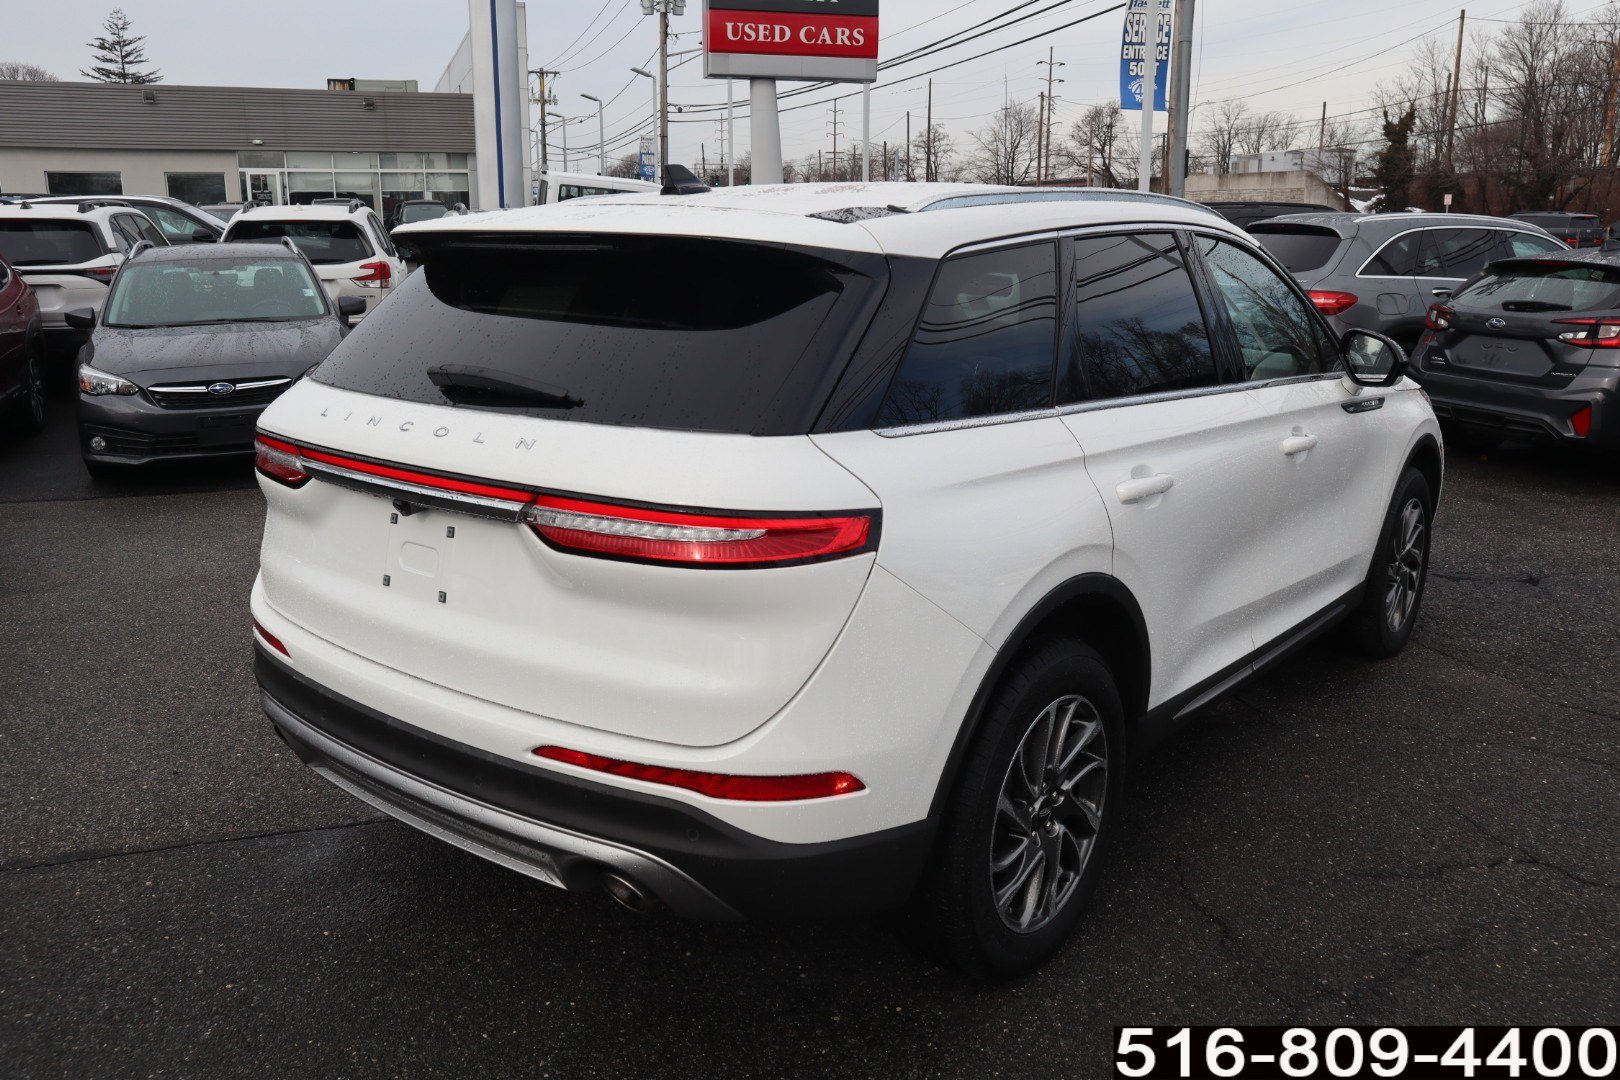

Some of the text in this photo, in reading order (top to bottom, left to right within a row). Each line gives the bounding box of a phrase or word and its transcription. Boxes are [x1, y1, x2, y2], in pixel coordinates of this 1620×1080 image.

[725, 22, 864, 46] USED CARS
[1124, 12, 1171, 44] SERCE
[1123, 45, 1168, 60] ENTRCE
[320, 407, 536, 451] LINCOLN
